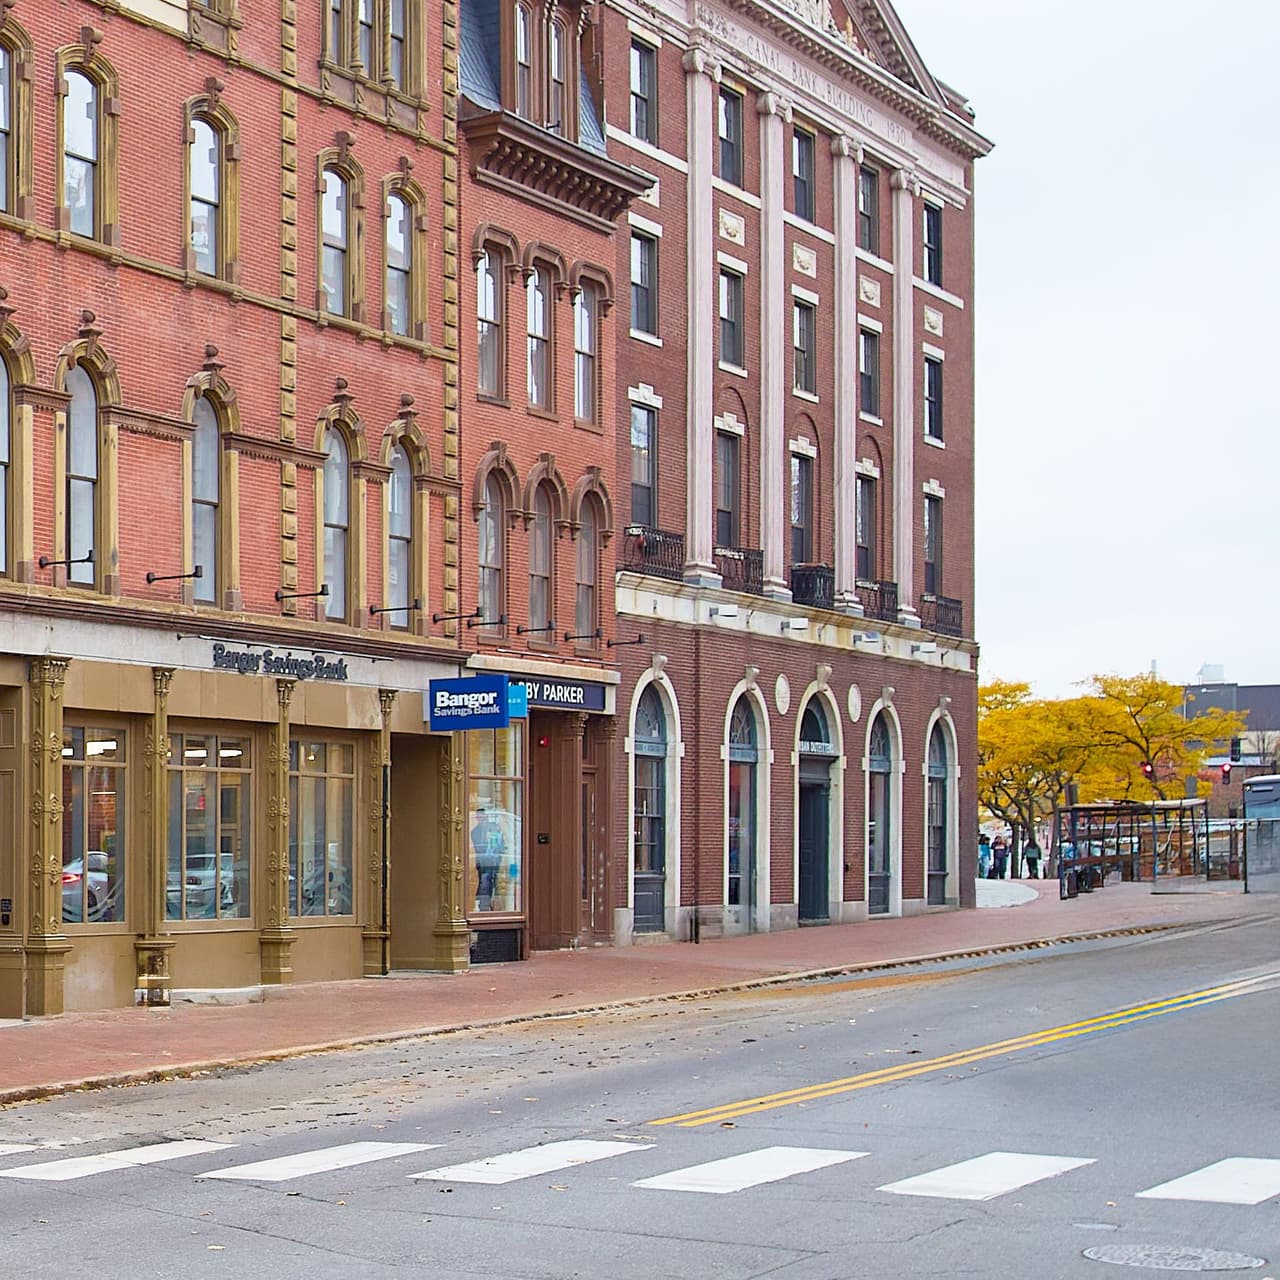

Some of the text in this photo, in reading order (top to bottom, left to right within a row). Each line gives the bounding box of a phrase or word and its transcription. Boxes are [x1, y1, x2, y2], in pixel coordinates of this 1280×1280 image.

[746, 35, 781, 73] CANAL
[791, 61, 816, 94] BANK
[826, 83, 873, 127] BUILDING
[213, 643, 347, 680] Bangor Savings Bank
[436, 691, 497, 708] Bangor
[544, 685, 584, 704] PARKER
[434, 704, 500, 717] Savings Bank
